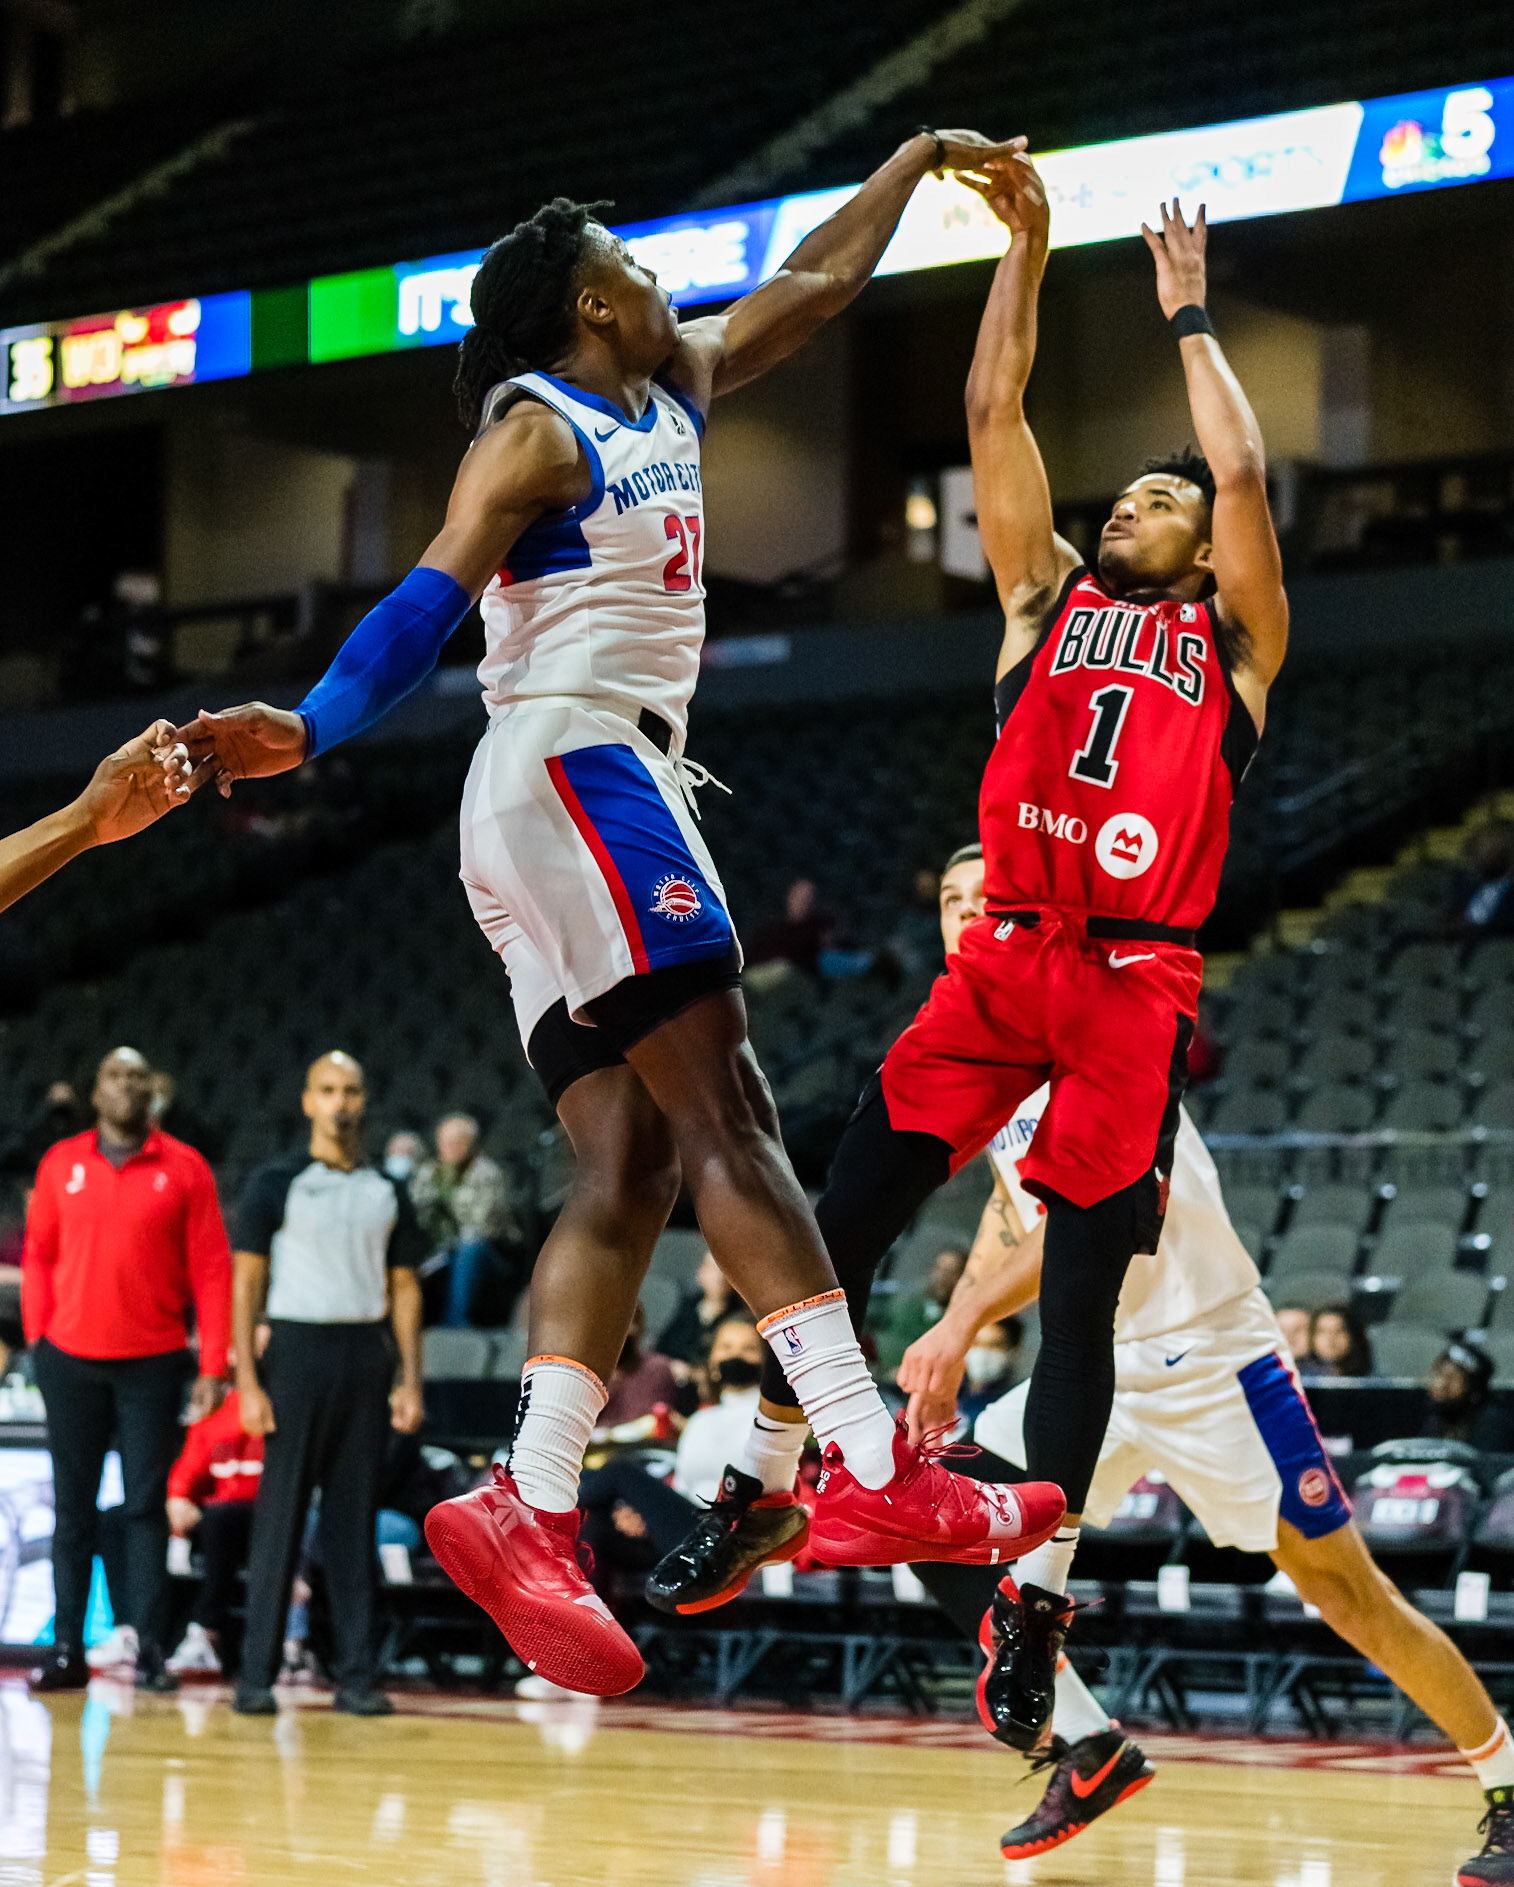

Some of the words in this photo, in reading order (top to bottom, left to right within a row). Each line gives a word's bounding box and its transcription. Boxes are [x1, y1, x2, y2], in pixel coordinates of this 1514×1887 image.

[1440, 87, 1495, 158] 5
[606, 462, 677, 515] MOTOR
[674, 462, 702, 493] CIT
[1049, 606, 1207, 706] BULLS
[1068, 682, 1134, 789] 1
[1017, 801, 1088, 845] BMO
